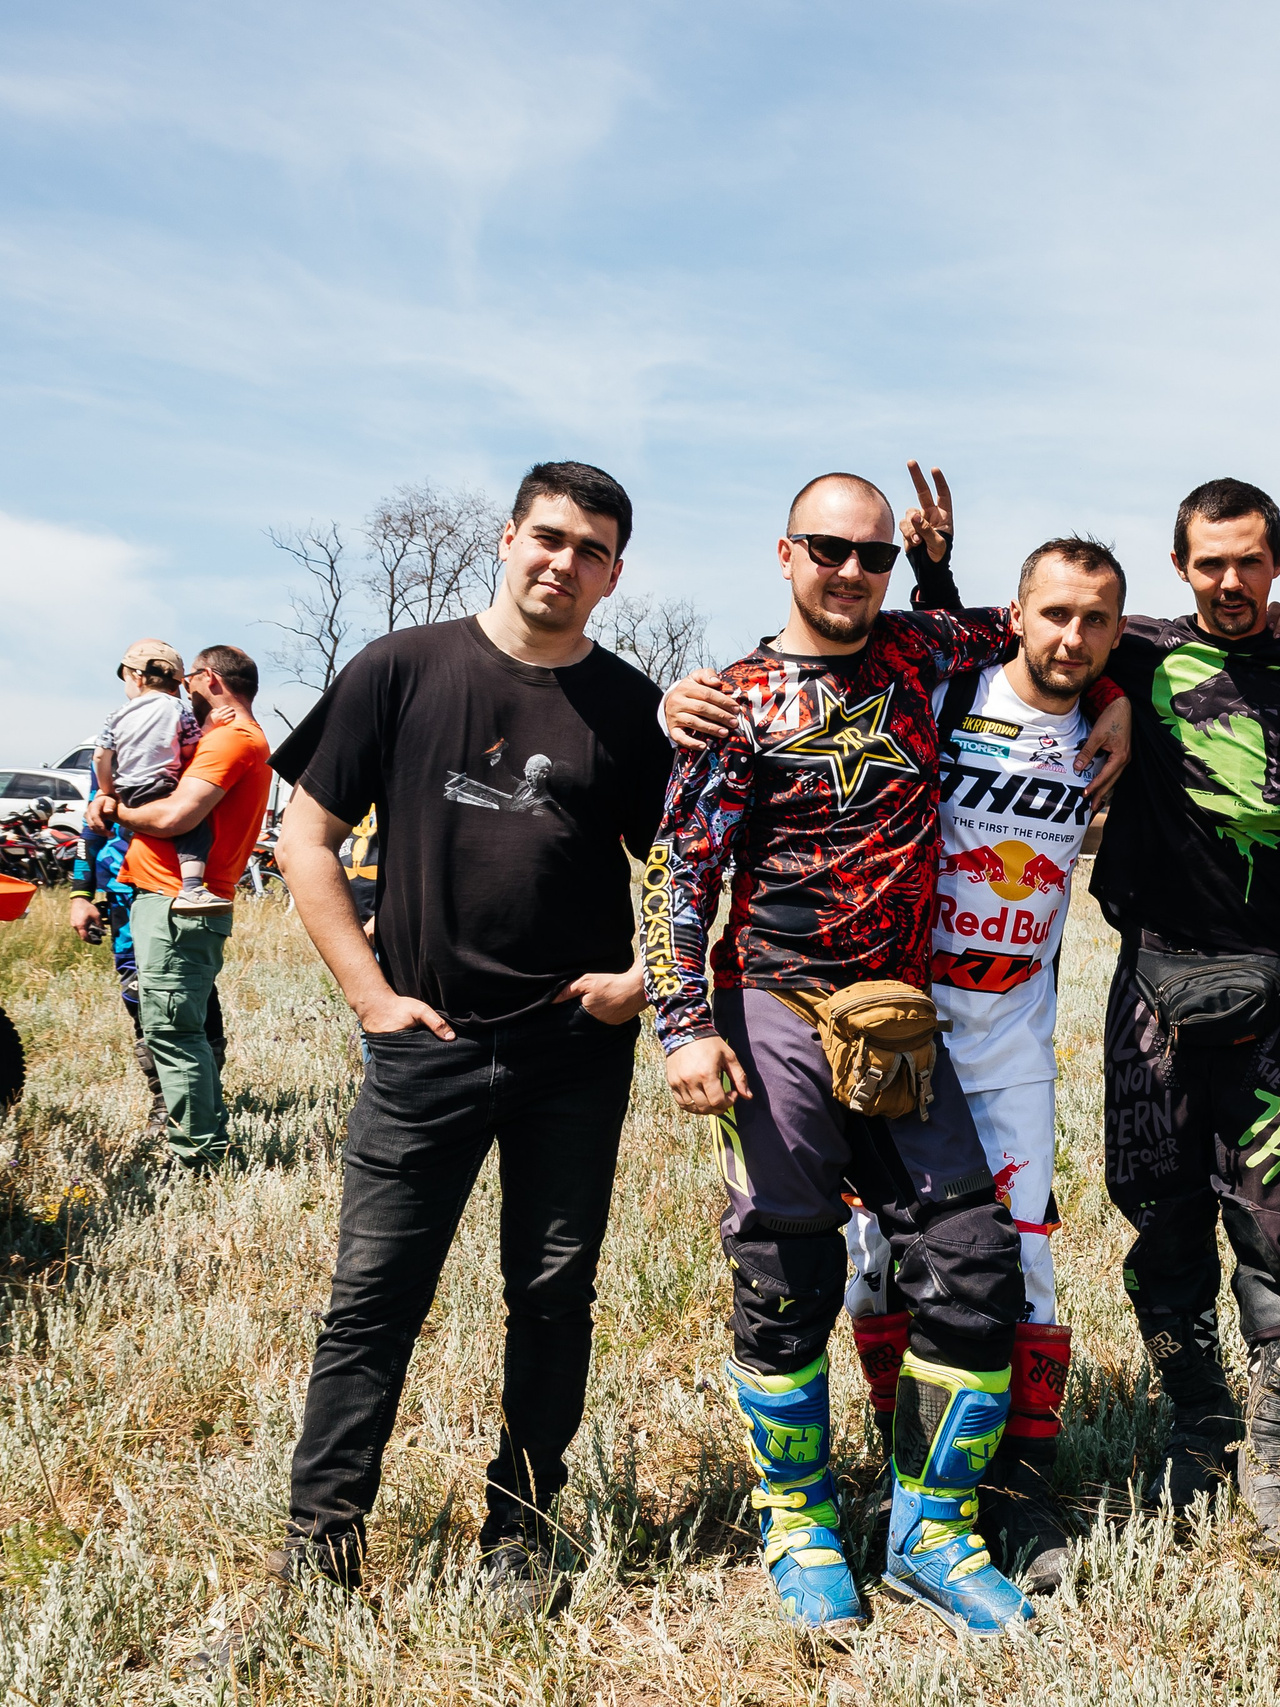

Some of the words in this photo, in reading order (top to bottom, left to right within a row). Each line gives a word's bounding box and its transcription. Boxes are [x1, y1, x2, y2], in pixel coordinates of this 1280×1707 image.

[953, 816, 975, 829] THE
[978, 821, 1010, 835] FIRST
[1013, 827, 1033, 839] THE
[1035, 830, 1075, 844] FOREVER
[931, 893, 1009, 943] Red
